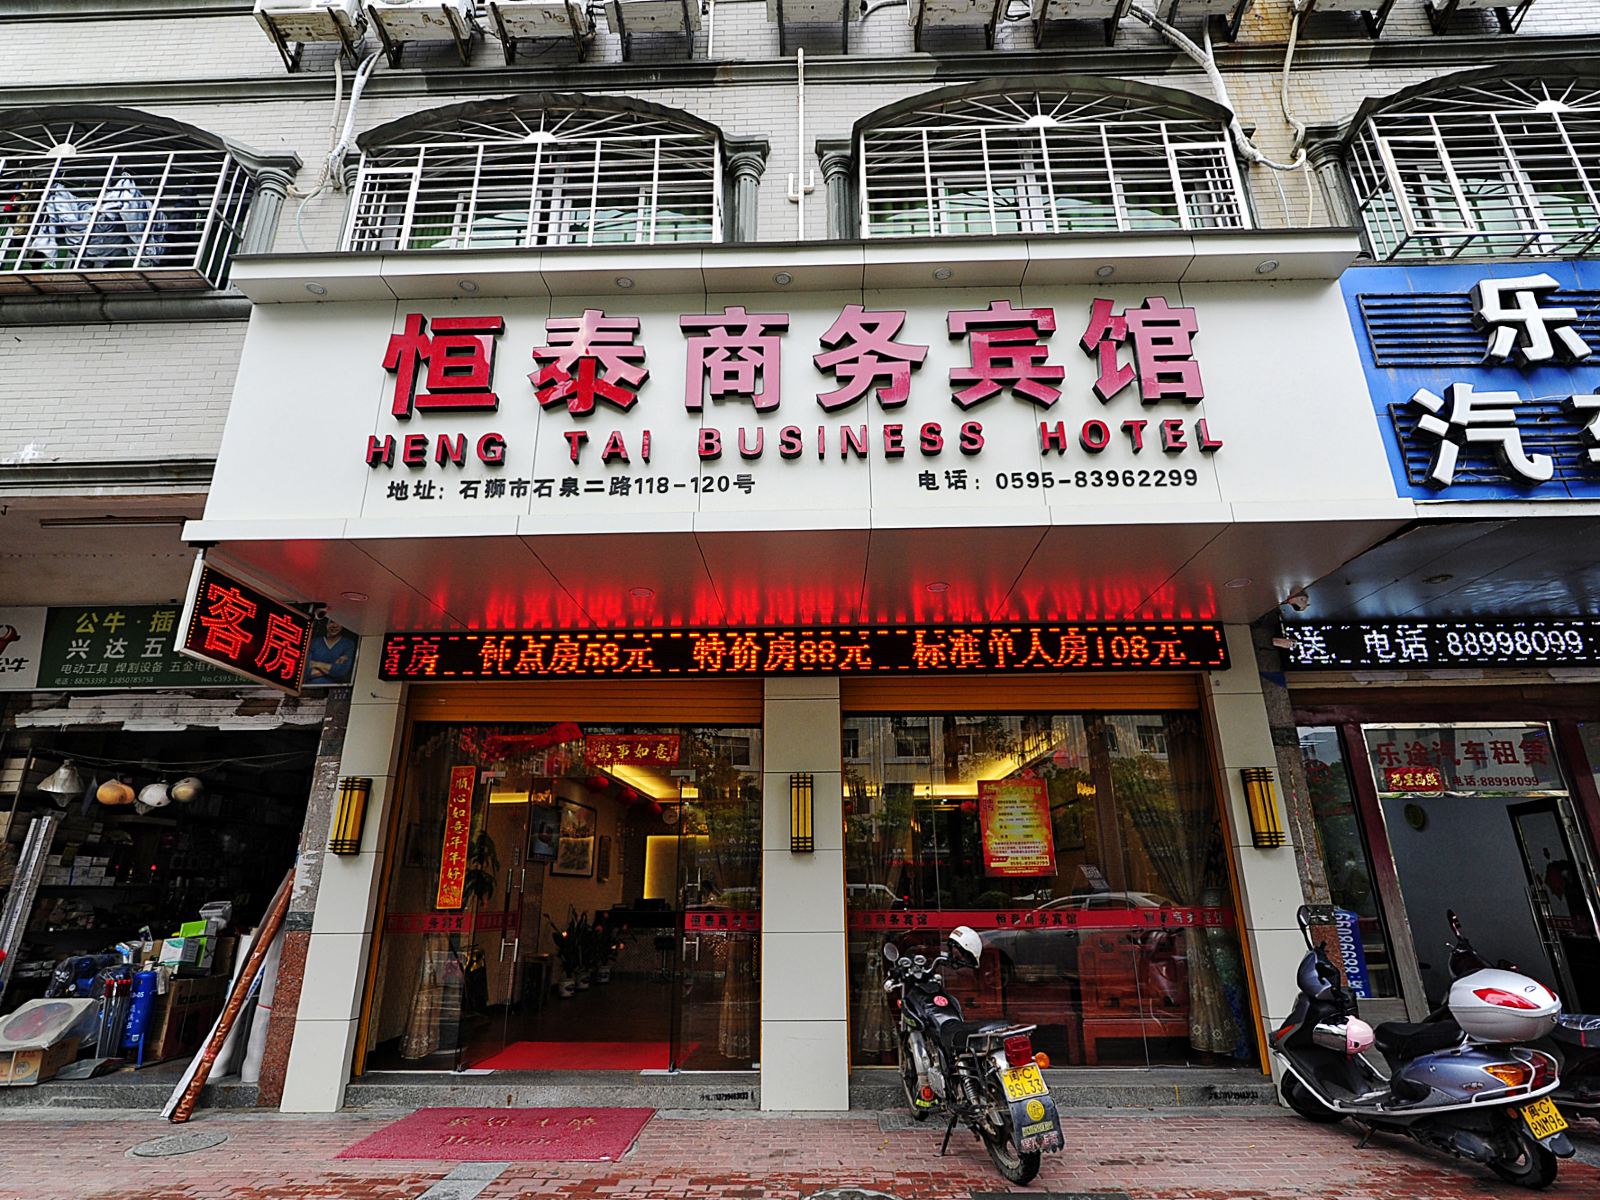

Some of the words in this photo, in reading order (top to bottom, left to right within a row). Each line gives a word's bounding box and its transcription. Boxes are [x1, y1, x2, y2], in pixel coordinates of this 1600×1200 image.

[1471, 273, 1593, 366] 乐
[382, 295, 1205, 421] 恒泰商务宾馆
[366, 432, 507, 469] HENG
[563, 429, 651, 465] TAI
[698, 421, 985, 462] BUSINESS
[1039, 418, 1223, 456] HOTEL
[66, 637, 187, 660] 兴达五
[201, 582, 303, 681] 客房
[693, 634, 872, 671] 特价房88元
[60, 663, 109, 675] 电动工具
[1377, 739, 1549, 767] 乐途汽车租赁
